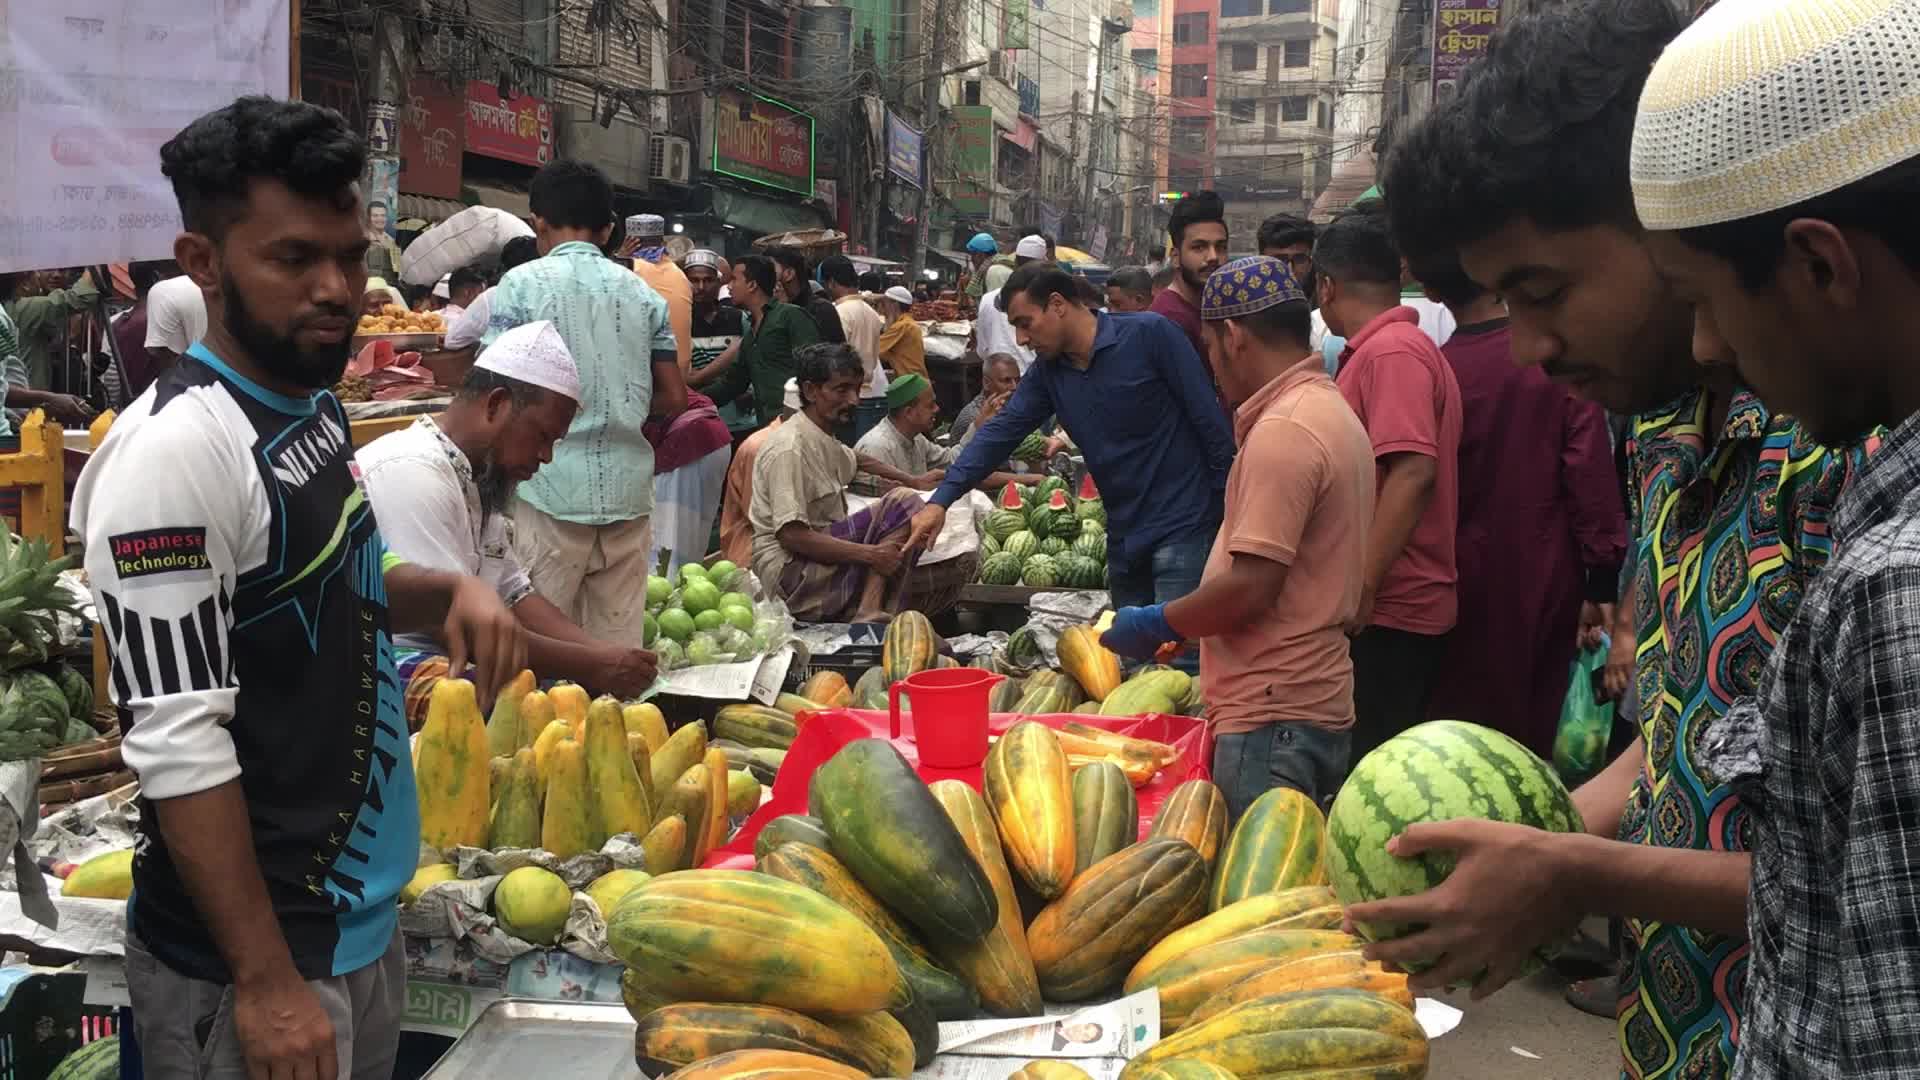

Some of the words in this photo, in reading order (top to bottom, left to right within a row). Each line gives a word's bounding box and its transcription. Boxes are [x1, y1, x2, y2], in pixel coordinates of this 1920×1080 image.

[1440, 9, 1497, 27] হাসান
[114, 533, 204, 556] Japanese
[117, 551, 208, 574] Technology
[350, 608, 375, 784] HARDWARE
